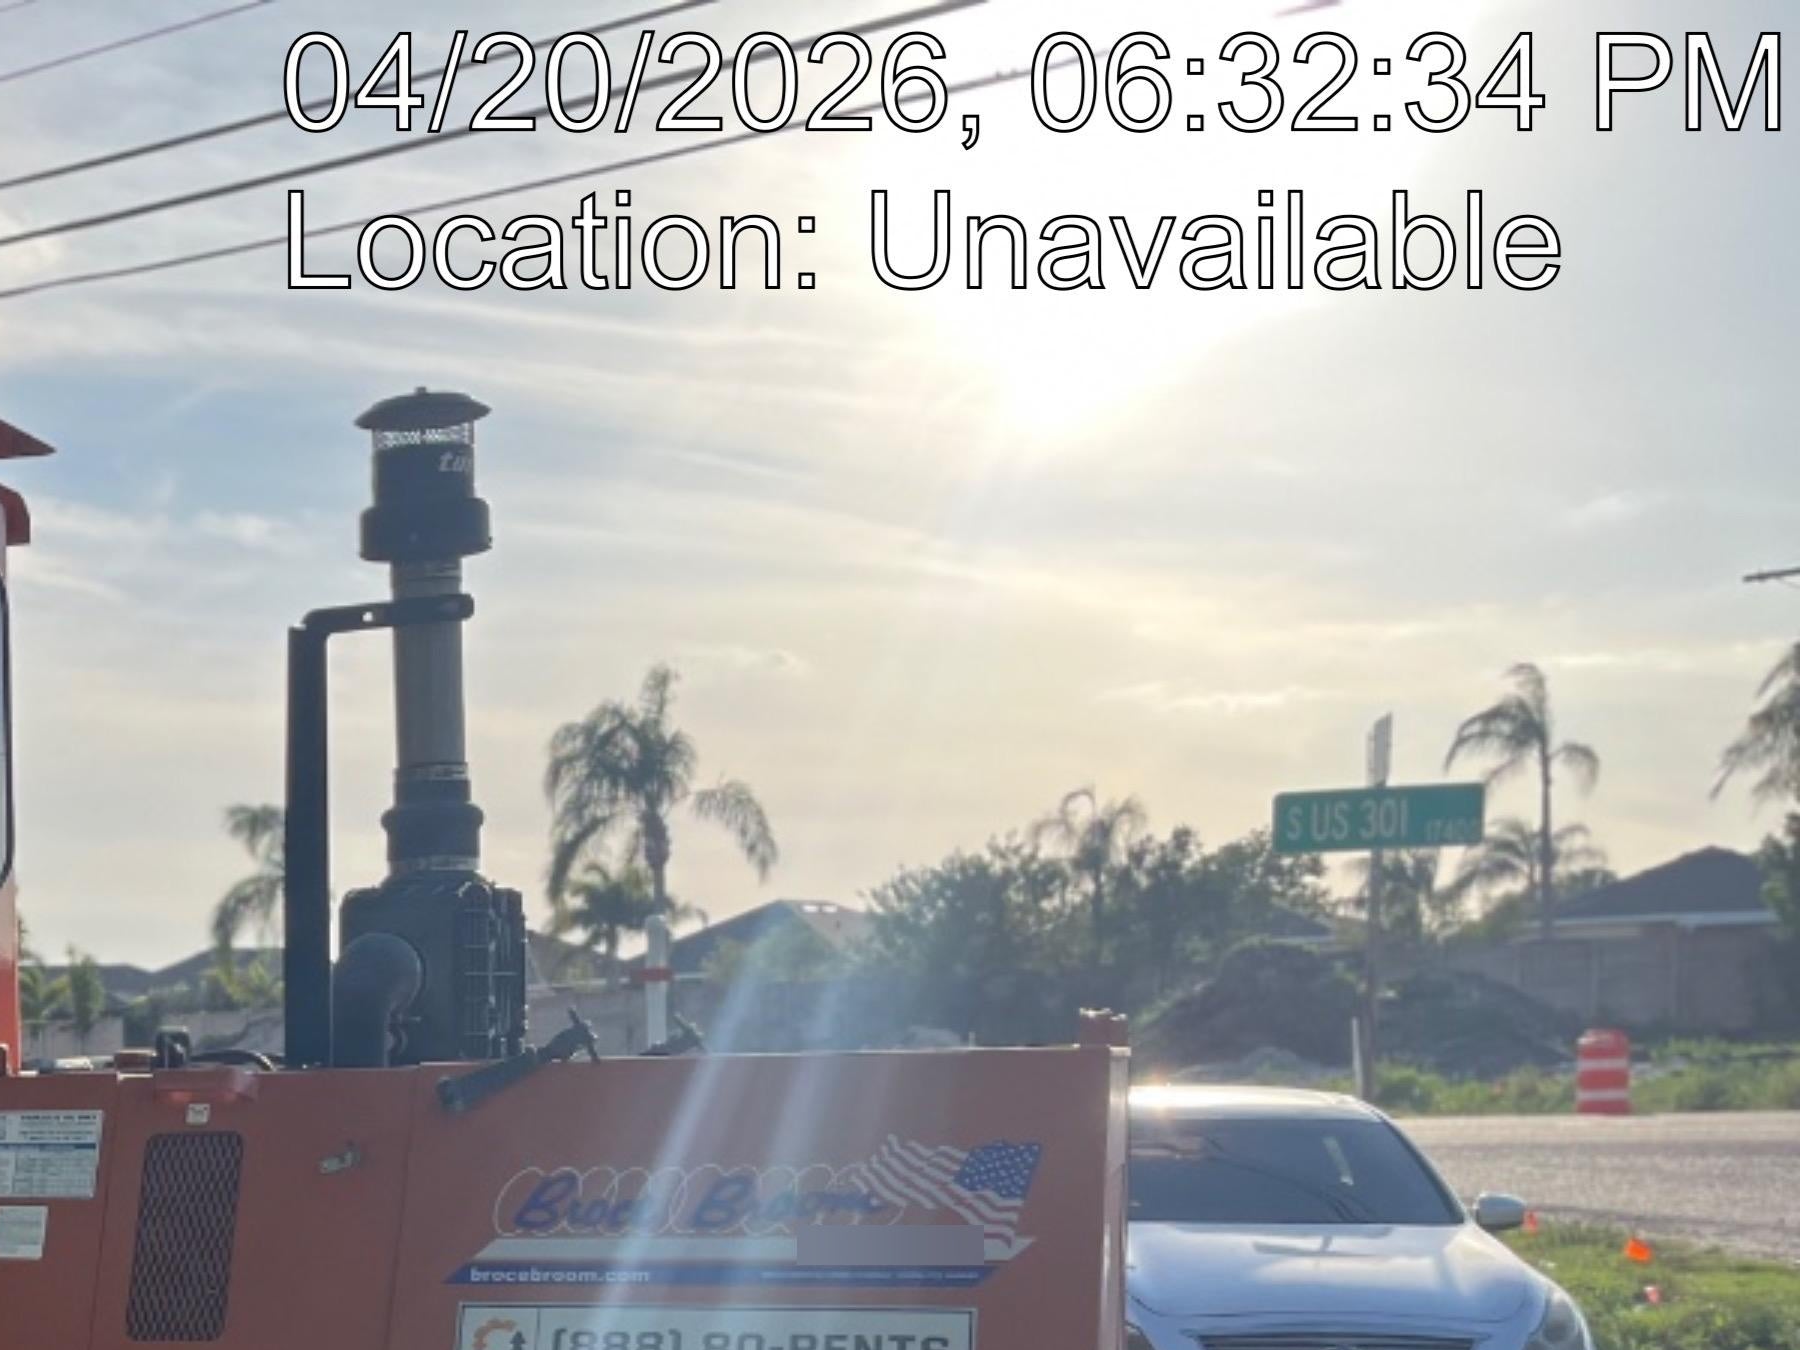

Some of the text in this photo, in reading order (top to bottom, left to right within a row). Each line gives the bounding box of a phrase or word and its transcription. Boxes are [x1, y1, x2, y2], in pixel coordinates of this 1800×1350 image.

[1286, 804, 1301, 842] S
[1310, 801, 1348, 842] US
[1358, 796, 1410, 840] 301
[469, 1266, 651, 1283] brocebroom.com
